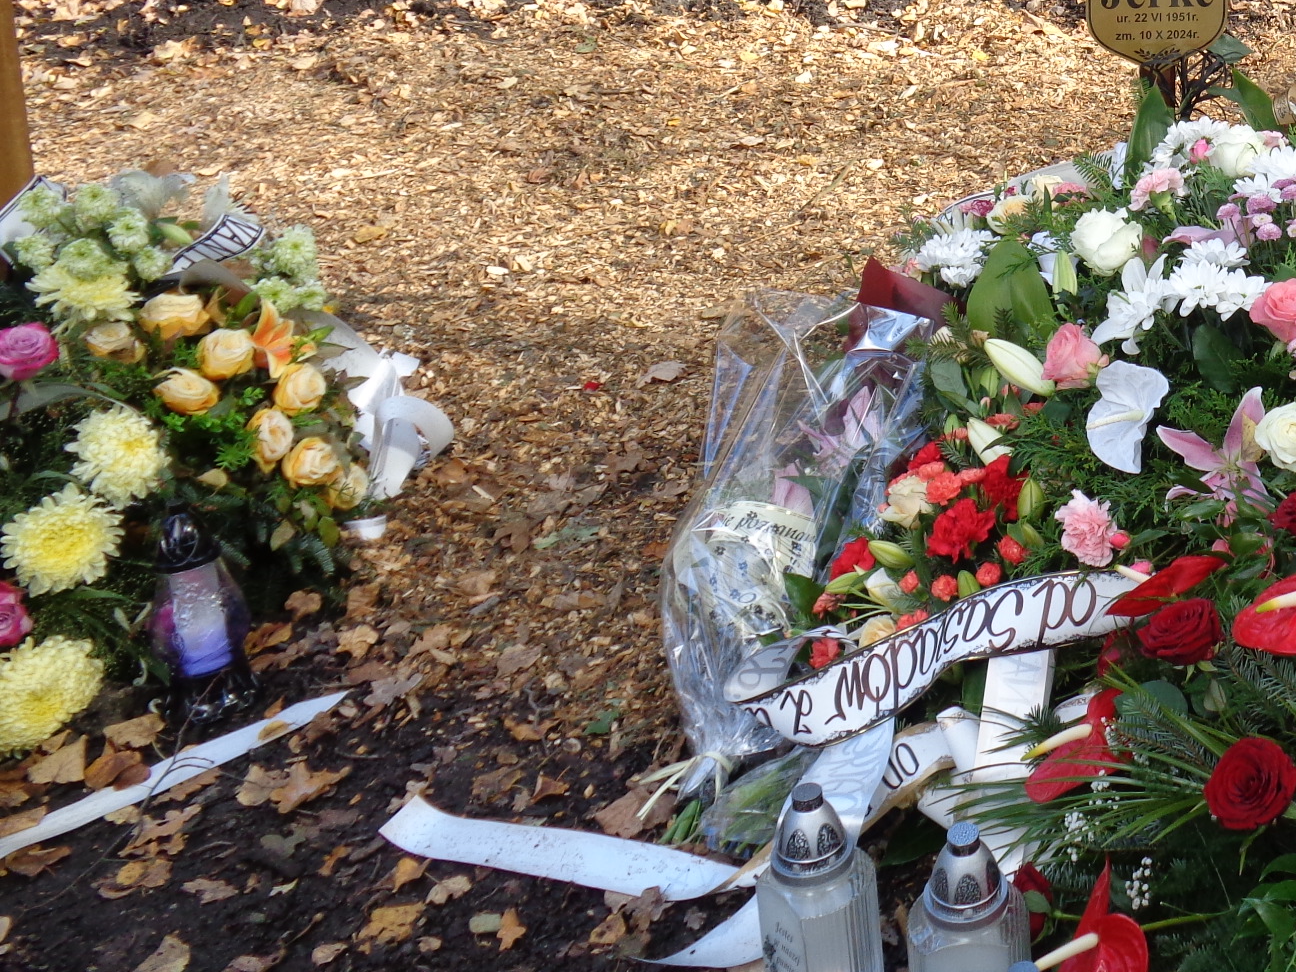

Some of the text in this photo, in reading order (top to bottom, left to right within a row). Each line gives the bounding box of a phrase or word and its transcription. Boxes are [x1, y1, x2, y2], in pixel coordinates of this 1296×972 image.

[1116, 12, 1199, 23] ur. 22 VI 1951r.
[1115, 29, 1200, 41] zm. 10 X 2024r.
[1033, 579, 1097, 647] od
